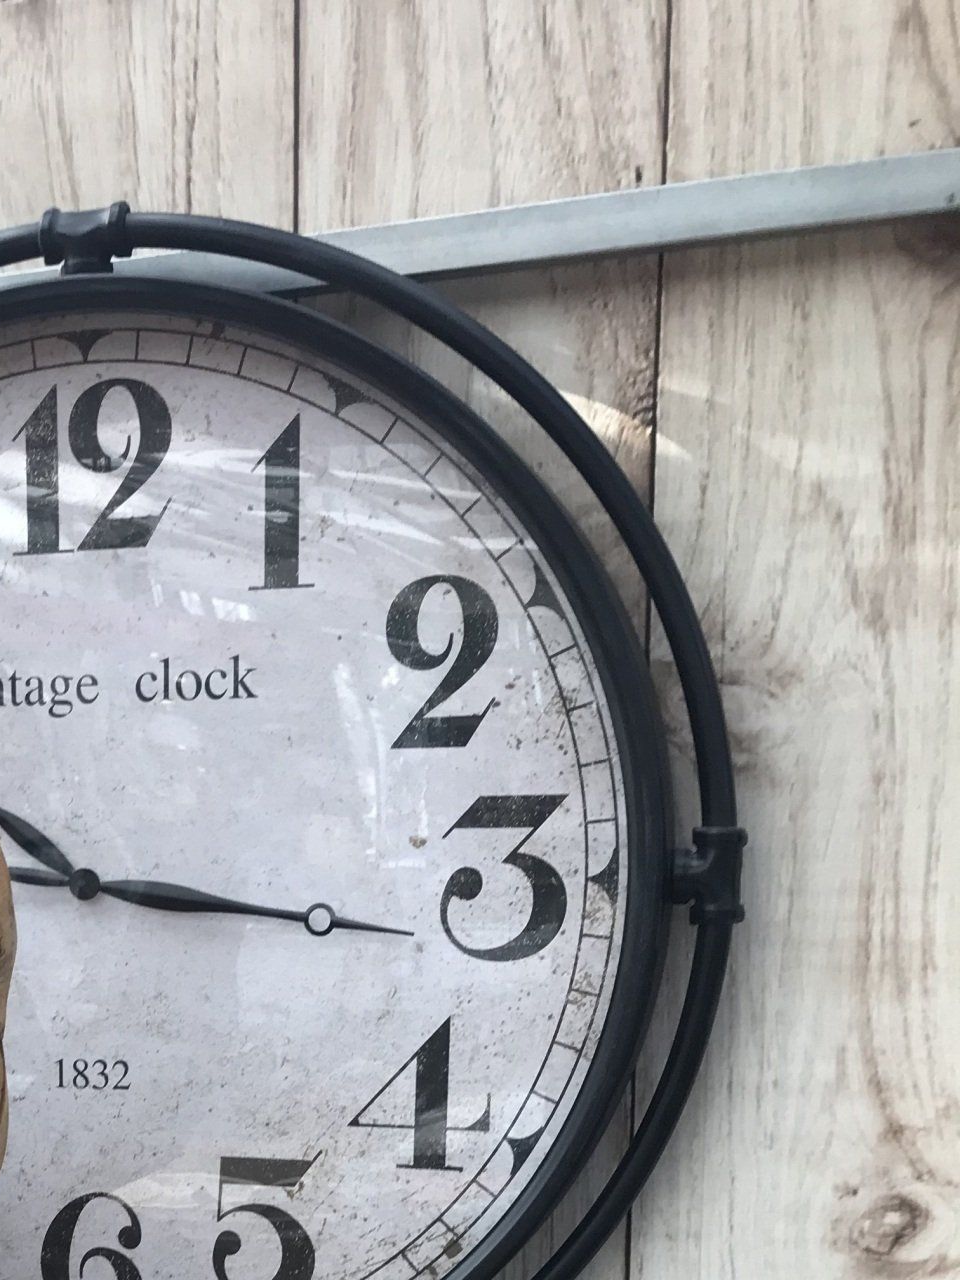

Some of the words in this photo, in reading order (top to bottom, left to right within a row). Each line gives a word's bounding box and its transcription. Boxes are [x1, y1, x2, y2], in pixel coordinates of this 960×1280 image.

[13, 378, 173, 557] 12
[248, 413, 315, 592] 1
[135, 653, 259, 703] clock
[386, 574, 499, 749] 2
[440, 793, 570, 962] 3
[54, 1057, 132, 1091] 1832
[347, 1015, 491, 1173] 4
